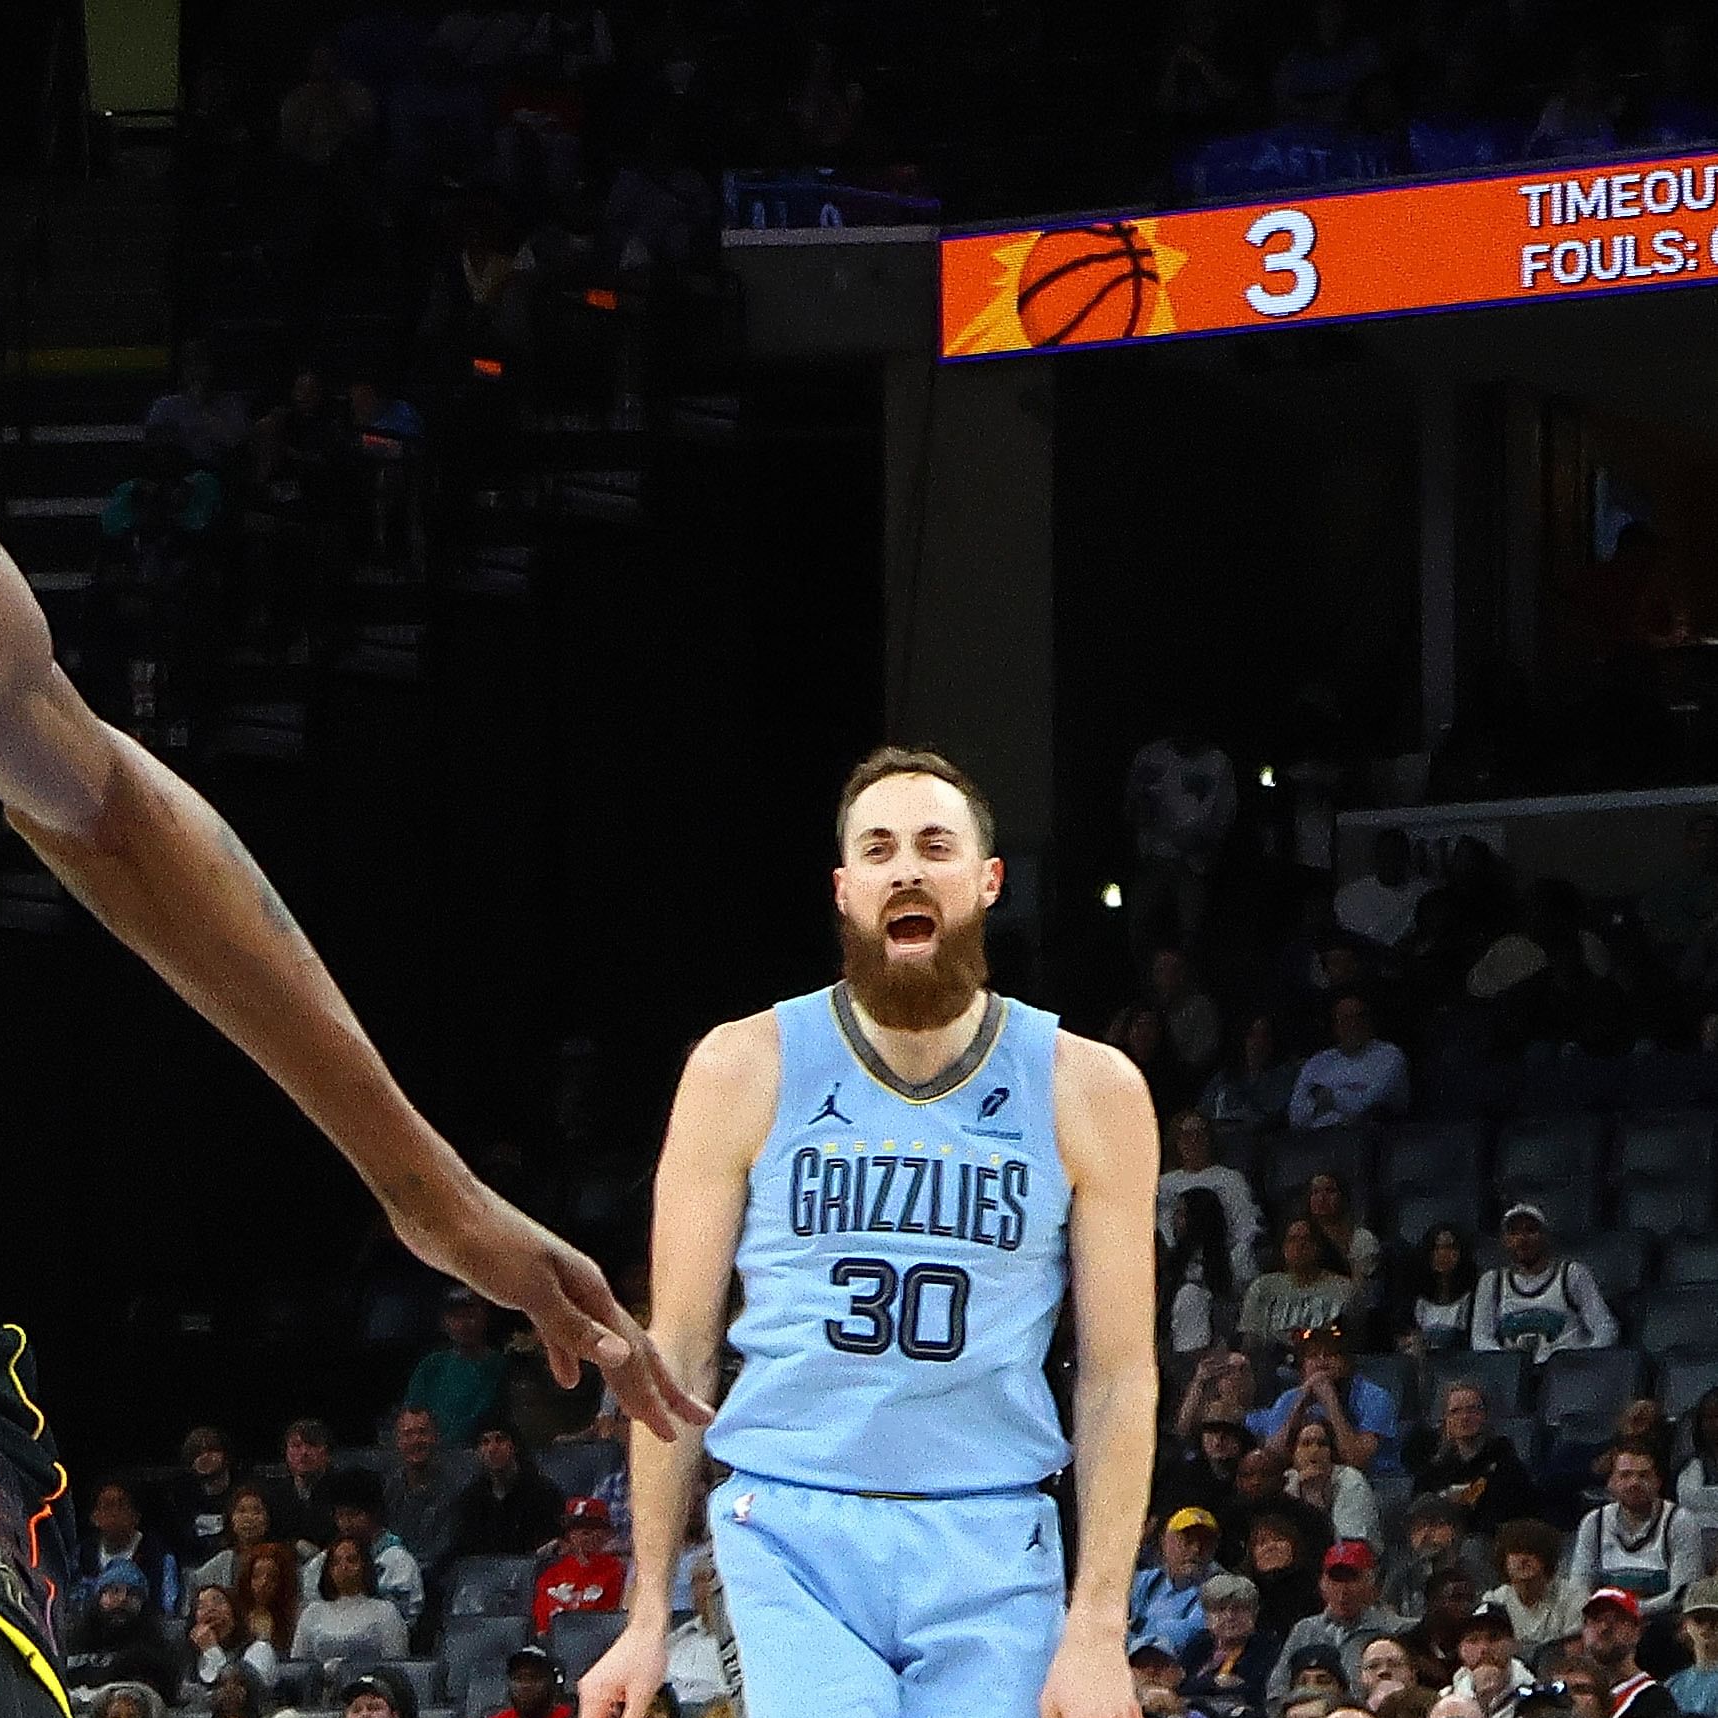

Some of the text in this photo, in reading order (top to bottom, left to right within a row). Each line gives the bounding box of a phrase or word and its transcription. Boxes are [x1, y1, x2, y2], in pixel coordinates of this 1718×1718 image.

[1519, 164, 1718, 227] TIMEOU
[1244, 209, 1320, 317] 3
[1520, 229, 1699, 288] FOULS:
[791, 1147, 1028, 1251] GRIZZLIES
[825, 1257, 970, 1362] 30
